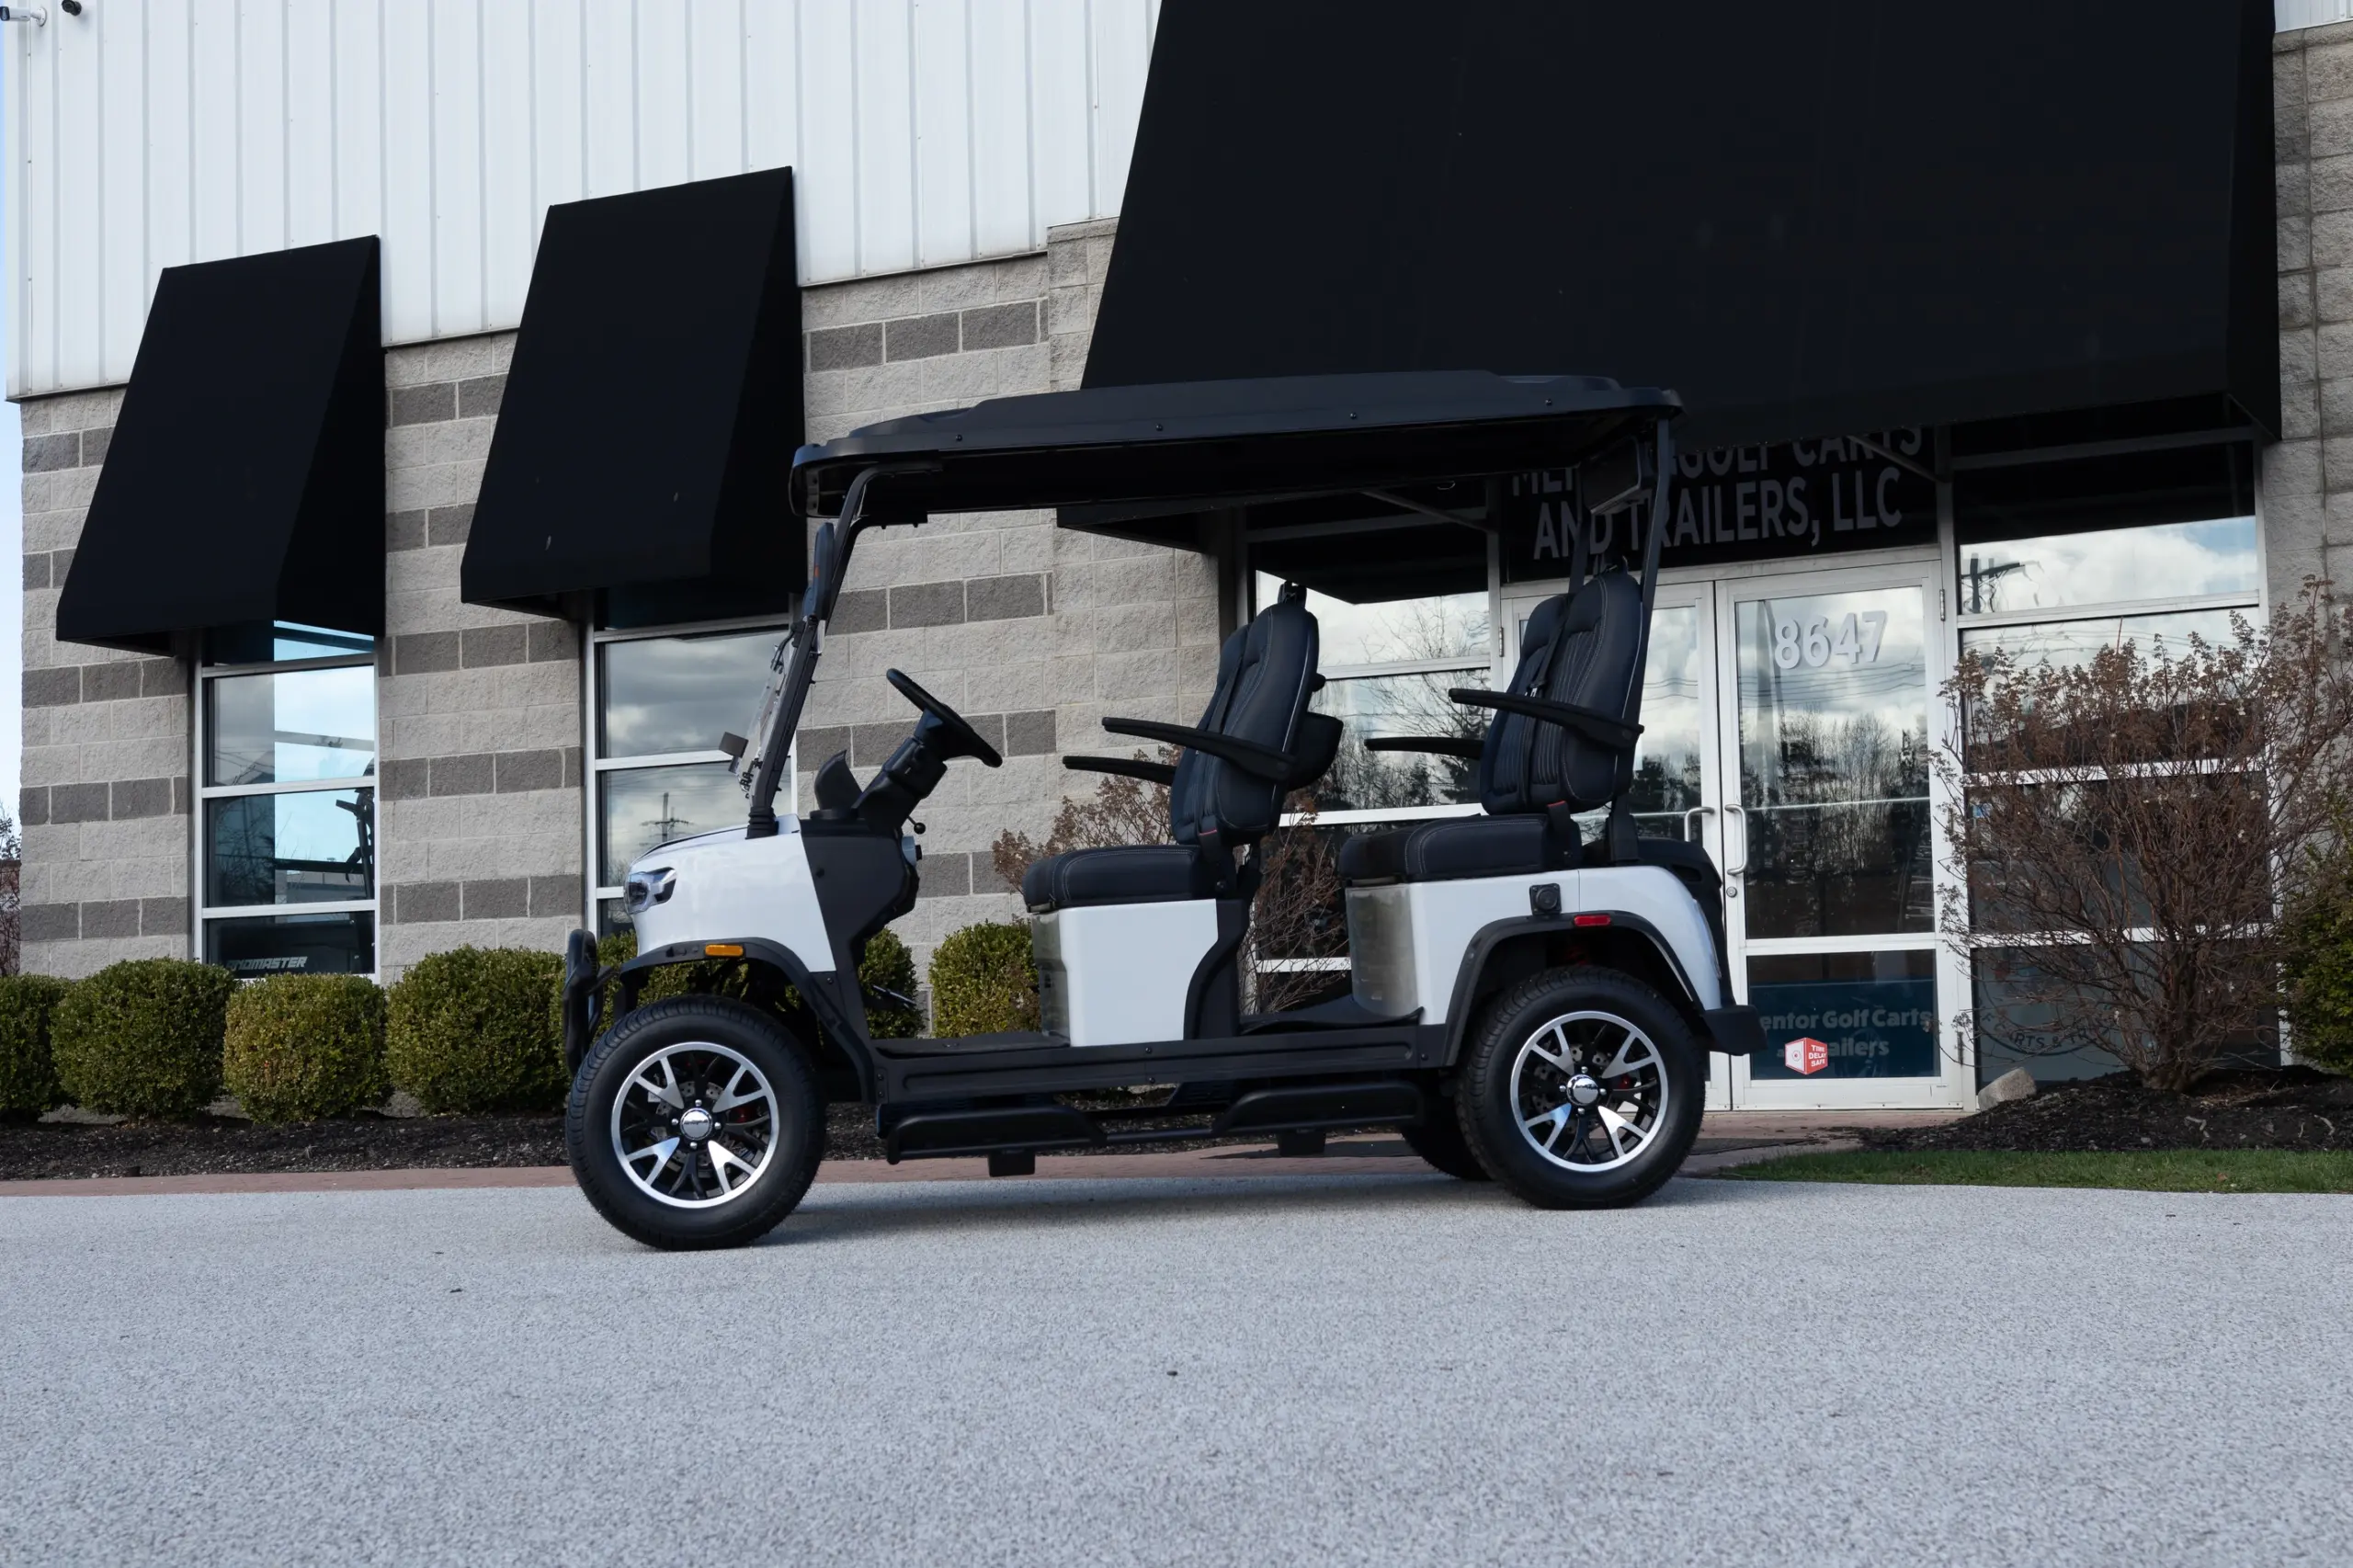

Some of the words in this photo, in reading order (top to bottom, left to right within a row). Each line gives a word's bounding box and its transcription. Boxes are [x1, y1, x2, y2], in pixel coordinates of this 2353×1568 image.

[1532, 500, 1614, 560] AND
[1832, 466, 1903, 531] LLC
[1774, 609, 1887, 669] 8647
[226, 956, 308, 970] ANDMASTER
[1759, 1012, 1819, 1030] entor
[1822, 1009, 1870, 1028] Golf
[1871, 1008, 1933, 1028] Carts
[1994, 1023, 2045, 1048] CRTS
[1808, 1051, 1827, 1060] DELAY
[1827, 1037, 1890, 1057] ailers
[1811, 1058, 1825, 1067] SAFE
